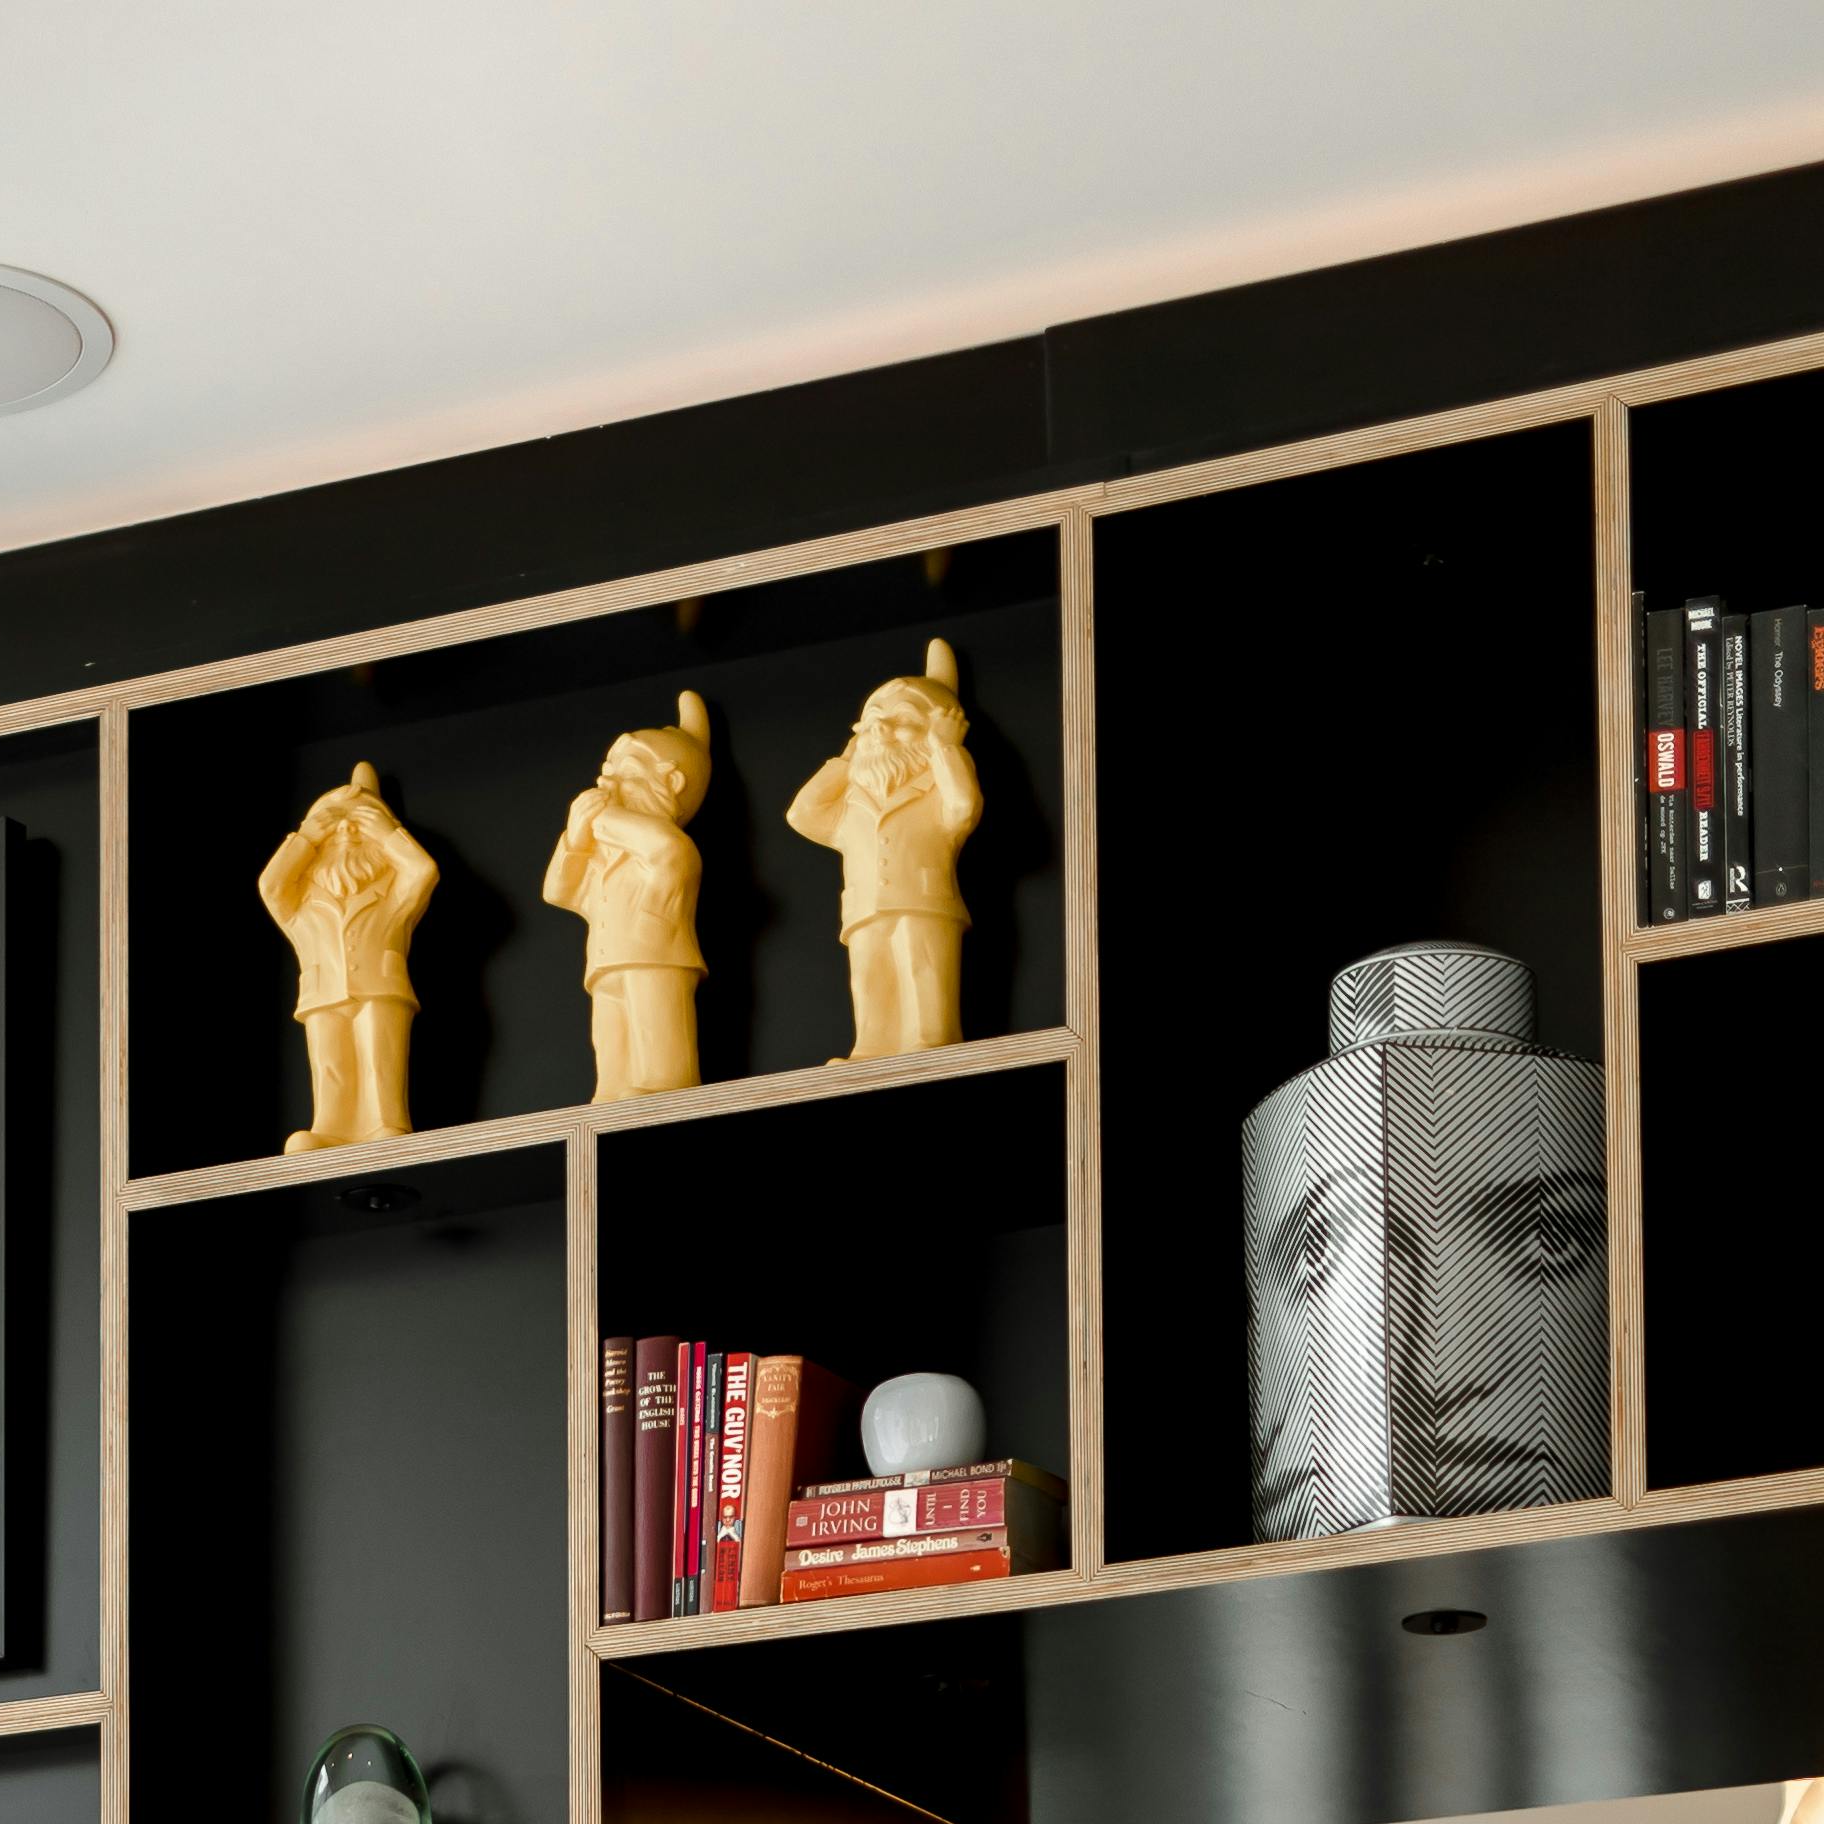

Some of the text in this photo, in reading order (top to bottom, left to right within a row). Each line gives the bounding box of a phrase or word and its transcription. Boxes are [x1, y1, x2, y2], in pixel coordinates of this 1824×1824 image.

[1697, 643, 1707, 669] THE
[1734, 635, 1743, 668] NOVEL
[1775, 651, 1783, 668] The
[1697, 671, 1707, 729] OFFICIAL
[1735, 671, 1744, 704] IMAGES
[1773, 669, 1783, 708] Odyssey
[1735, 705, 1744, 751] Literature
[1657, 732, 1675, 788] OSWALD
[1698, 811, 1709, 862] READER
[638, 1384, 677, 1396] GROWTH
[648, 1371, 665, 1381] THE
[639, 1395, 673, 1407] OF THE
[639, 1408, 674, 1420] ENGLISH
[641, 1419, 671, 1431] HOUSE
[720, 1361, 748, 1499] THE GUV'NOR
[931, 1467, 967, 1480] MICHAEL
[970, 1463, 995, 1476] BOND
[820, 1499, 871, 1520] JOHN
[925, 1492, 936, 1526] UNTIL
[959, 1488, 970, 1522] FIND
[976, 1490, 987, 1519] YOU
[811, 1516, 877, 1537] IRVING
[799, 1537, 958, 1566] Desire James Stephens
[838, 1574, 884, 1586] Thesaurus
